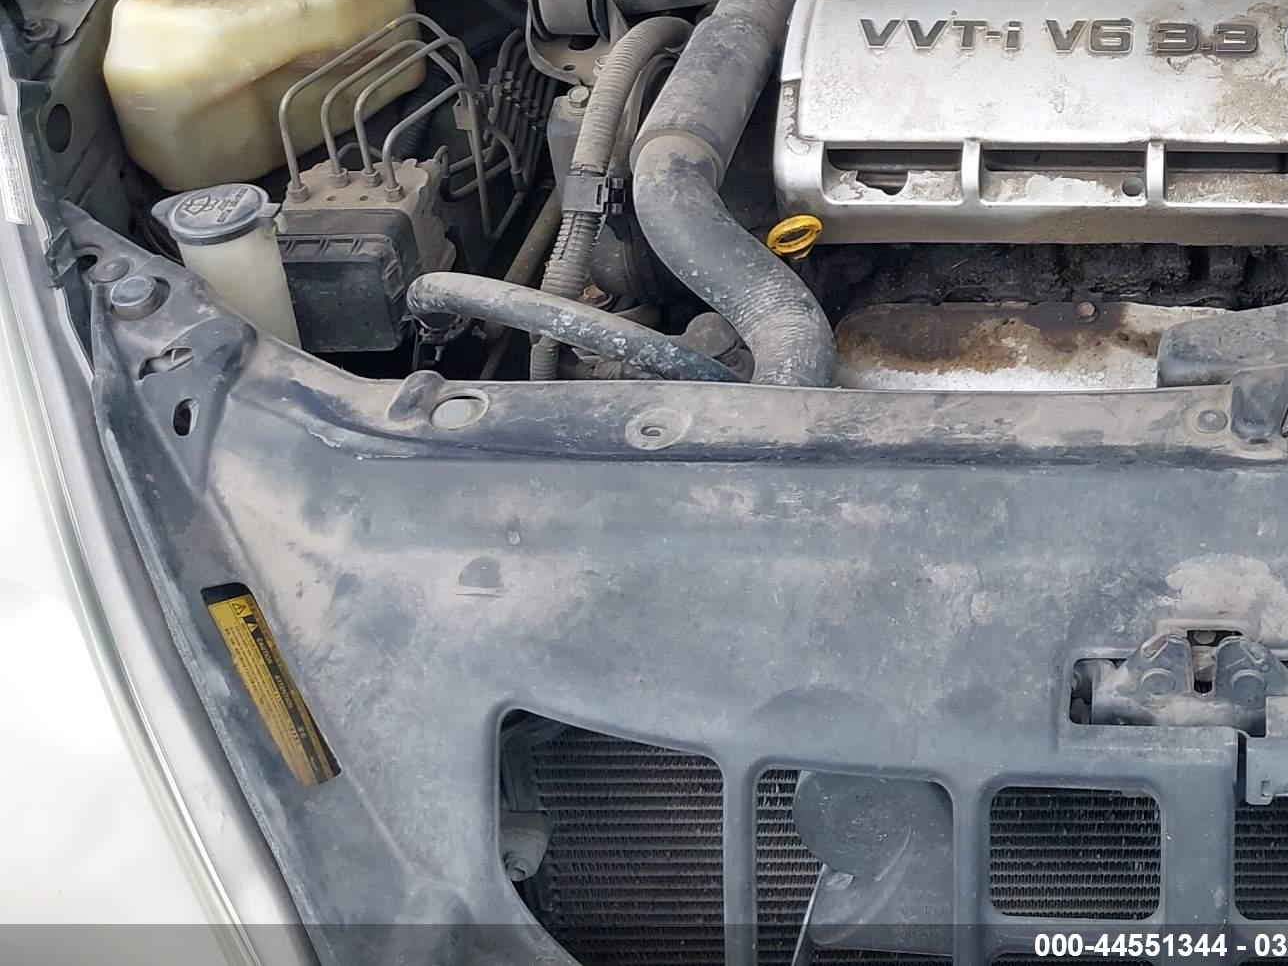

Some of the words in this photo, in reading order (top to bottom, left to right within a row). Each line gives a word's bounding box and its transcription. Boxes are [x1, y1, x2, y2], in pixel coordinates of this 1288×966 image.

[859, 17, 1021, 50] VVT-i
[1045, 17, 1132, 55] V6
[1155, 21, 1259, 56] 3.3
[256, 637, 273, 664] CAUTION
